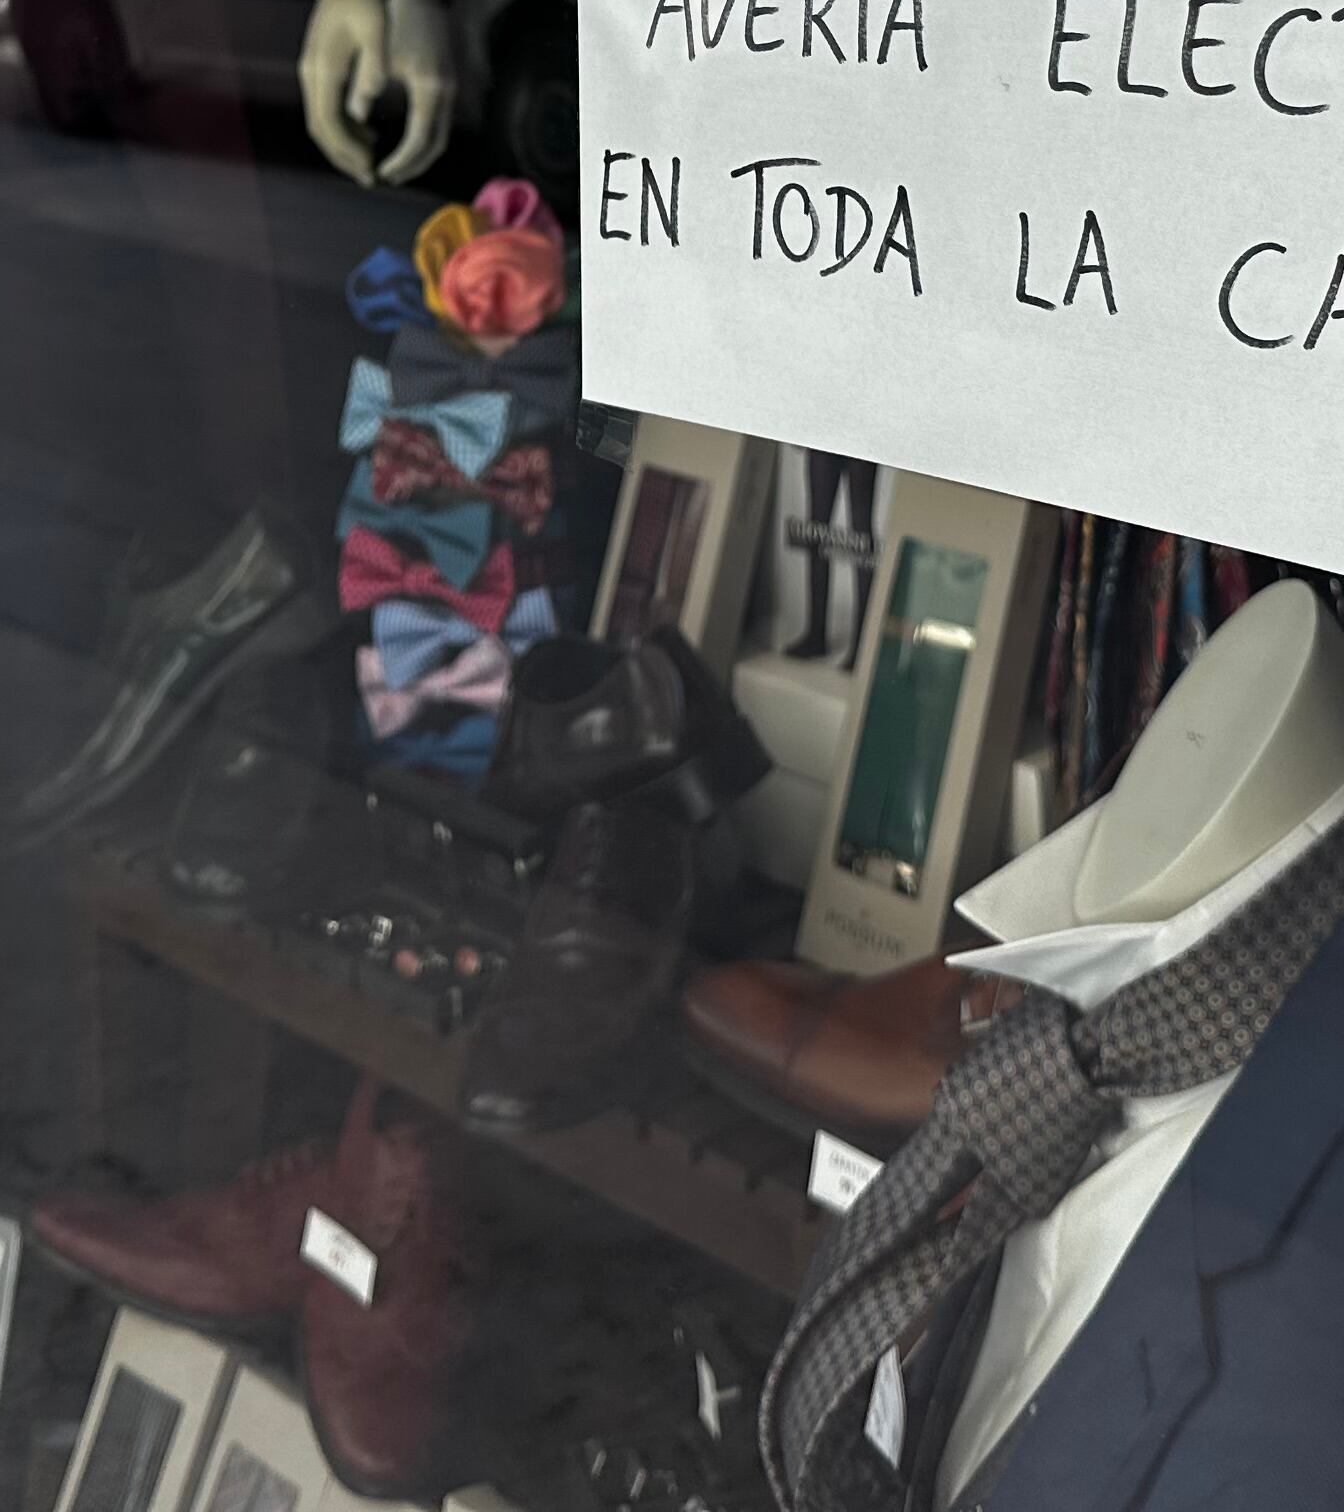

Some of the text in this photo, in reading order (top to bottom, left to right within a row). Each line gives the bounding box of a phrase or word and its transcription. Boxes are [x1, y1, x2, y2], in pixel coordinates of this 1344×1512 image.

[599, 149, 682, 248] EN
[730, 157, 924, 297] TODA
[1014, 209, 1119, 317] LA
